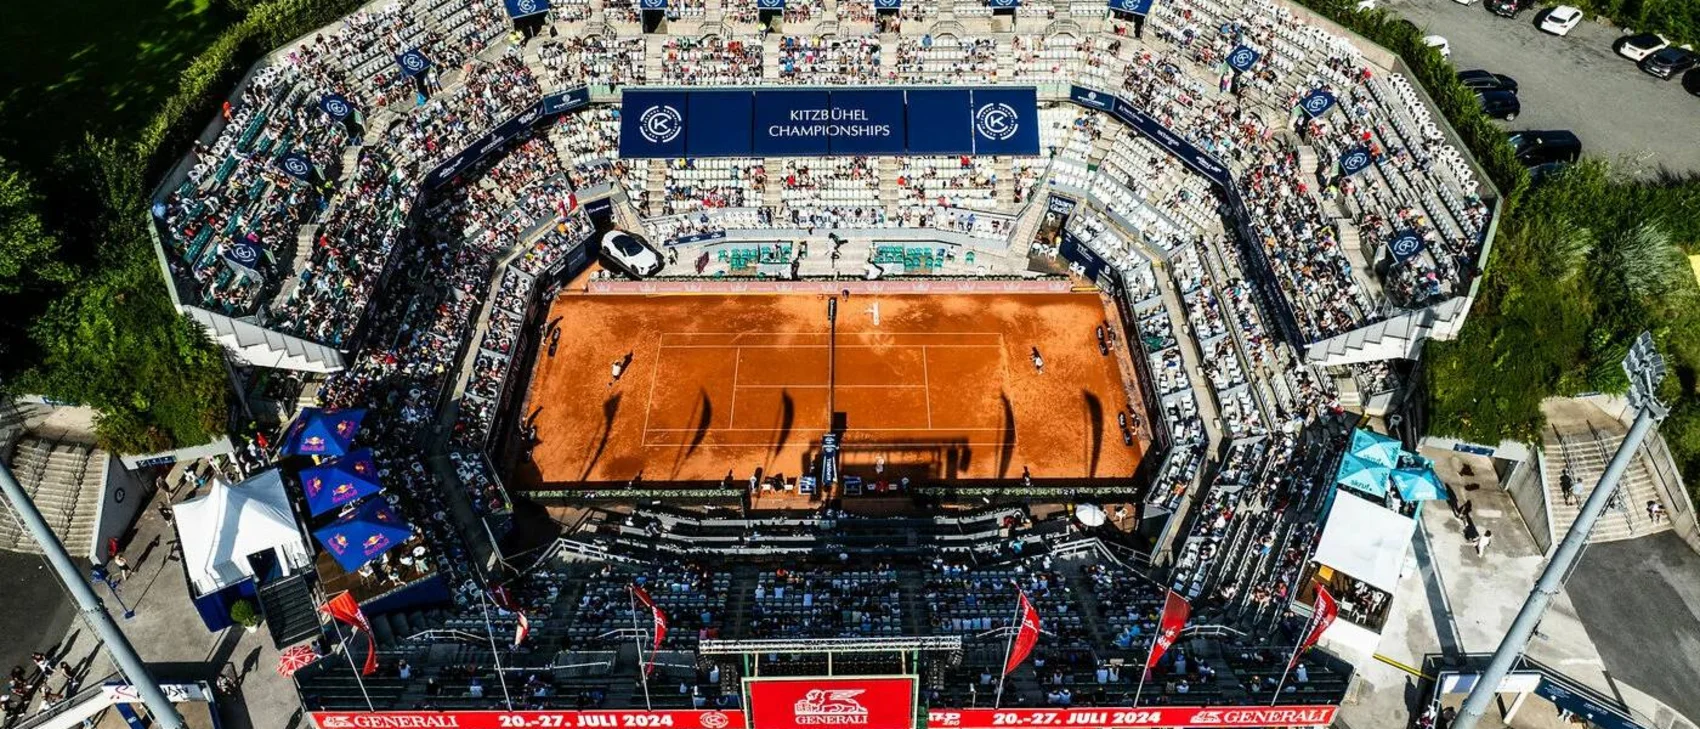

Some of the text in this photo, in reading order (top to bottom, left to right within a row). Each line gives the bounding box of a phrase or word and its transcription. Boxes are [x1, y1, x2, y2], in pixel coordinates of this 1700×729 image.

[790, 107, 869, 121] KITZBÜHEL
[768, 125, 891, 137] CHAMPIONSHIPS
[354, 715, 459, 728] GENERALI
[499, 714, 673, 727] 20.-27. JULI 2024
[795, 715, 869, 725] GENERALI
[992, 711, 1161, 725] 20.-27. JULI 2024
[1223, 709, 1331, 724] GENERALI
